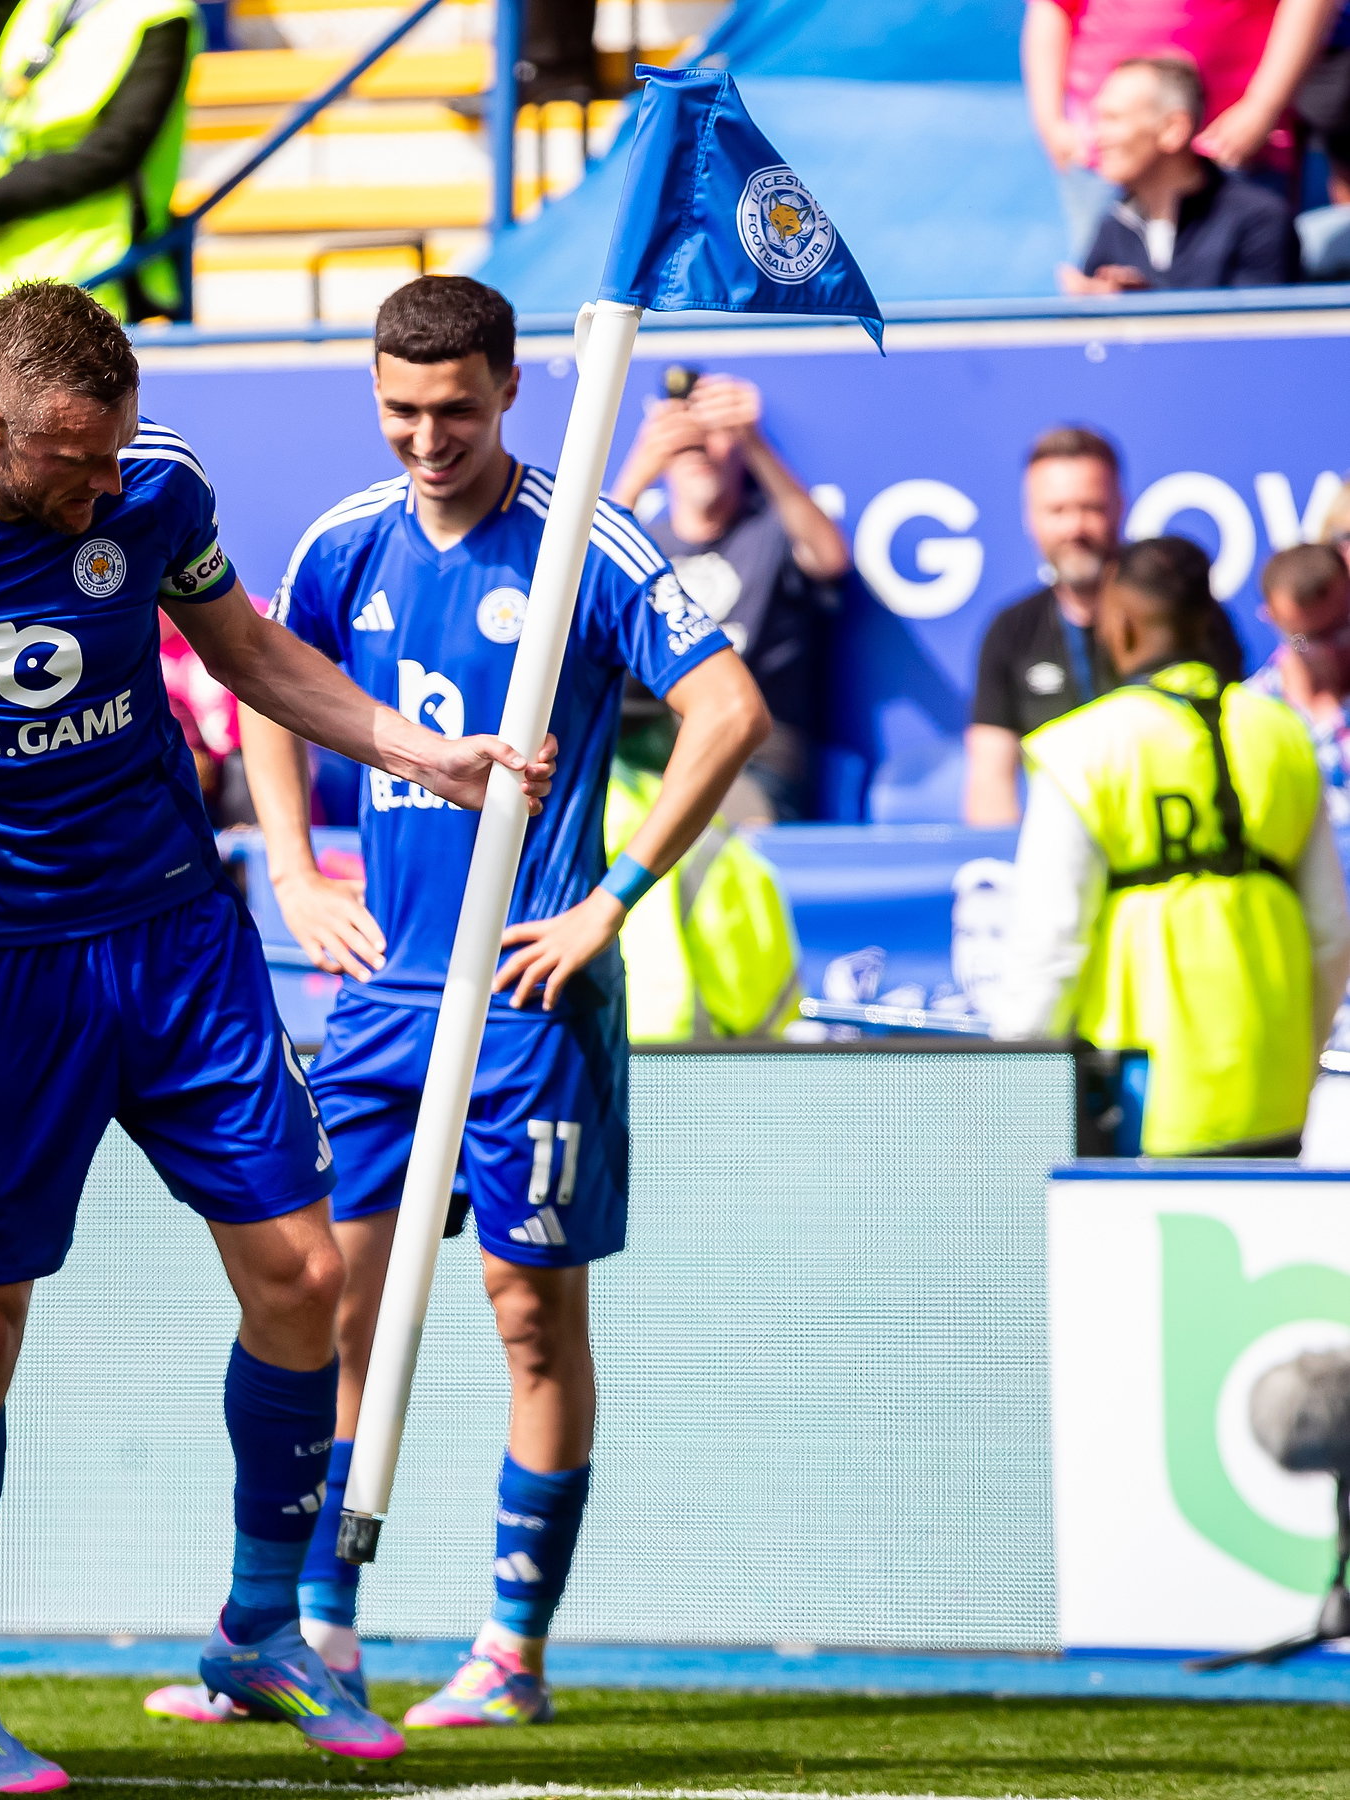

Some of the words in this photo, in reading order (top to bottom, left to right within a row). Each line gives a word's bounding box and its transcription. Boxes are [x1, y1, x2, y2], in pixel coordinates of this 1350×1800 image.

[748, 213, 795, 274] FOOTBALL
[795, 242, 824, 272] CLUB
[78, 543, 107, 572] LEICESTER
[107, 545, 121, 561] CITY
[196, 547, 225, 579] Cap
[80, 573, 114, 592] FOOTBALL
[527, 1118, 582, 1205] 11
